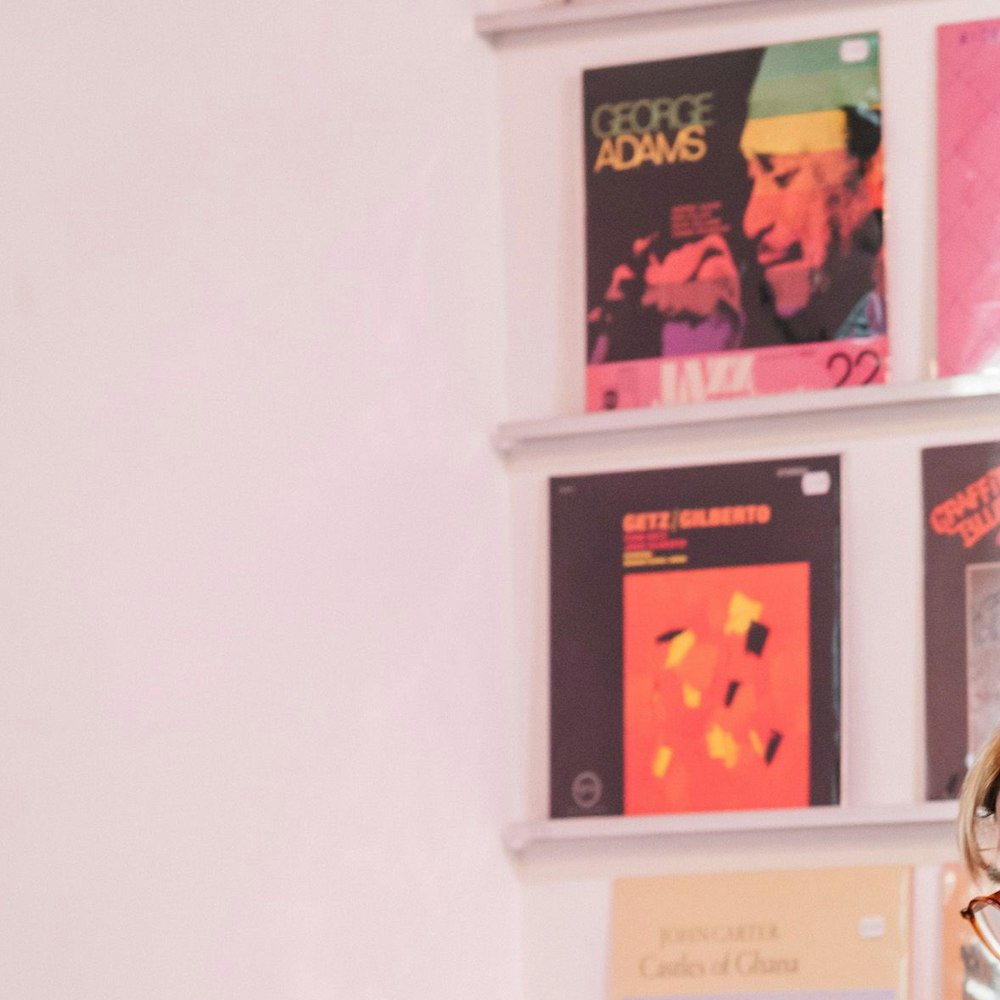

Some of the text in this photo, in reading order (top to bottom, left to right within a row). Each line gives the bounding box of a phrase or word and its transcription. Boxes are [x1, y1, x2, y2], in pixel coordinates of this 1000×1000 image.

[592, 91, 713, 138] GEORGE
[594, 124, 706, 173] ADAMS
[826, 350, 880, 389] 22
[638, 947, 799, 980] Castles of Ghana
